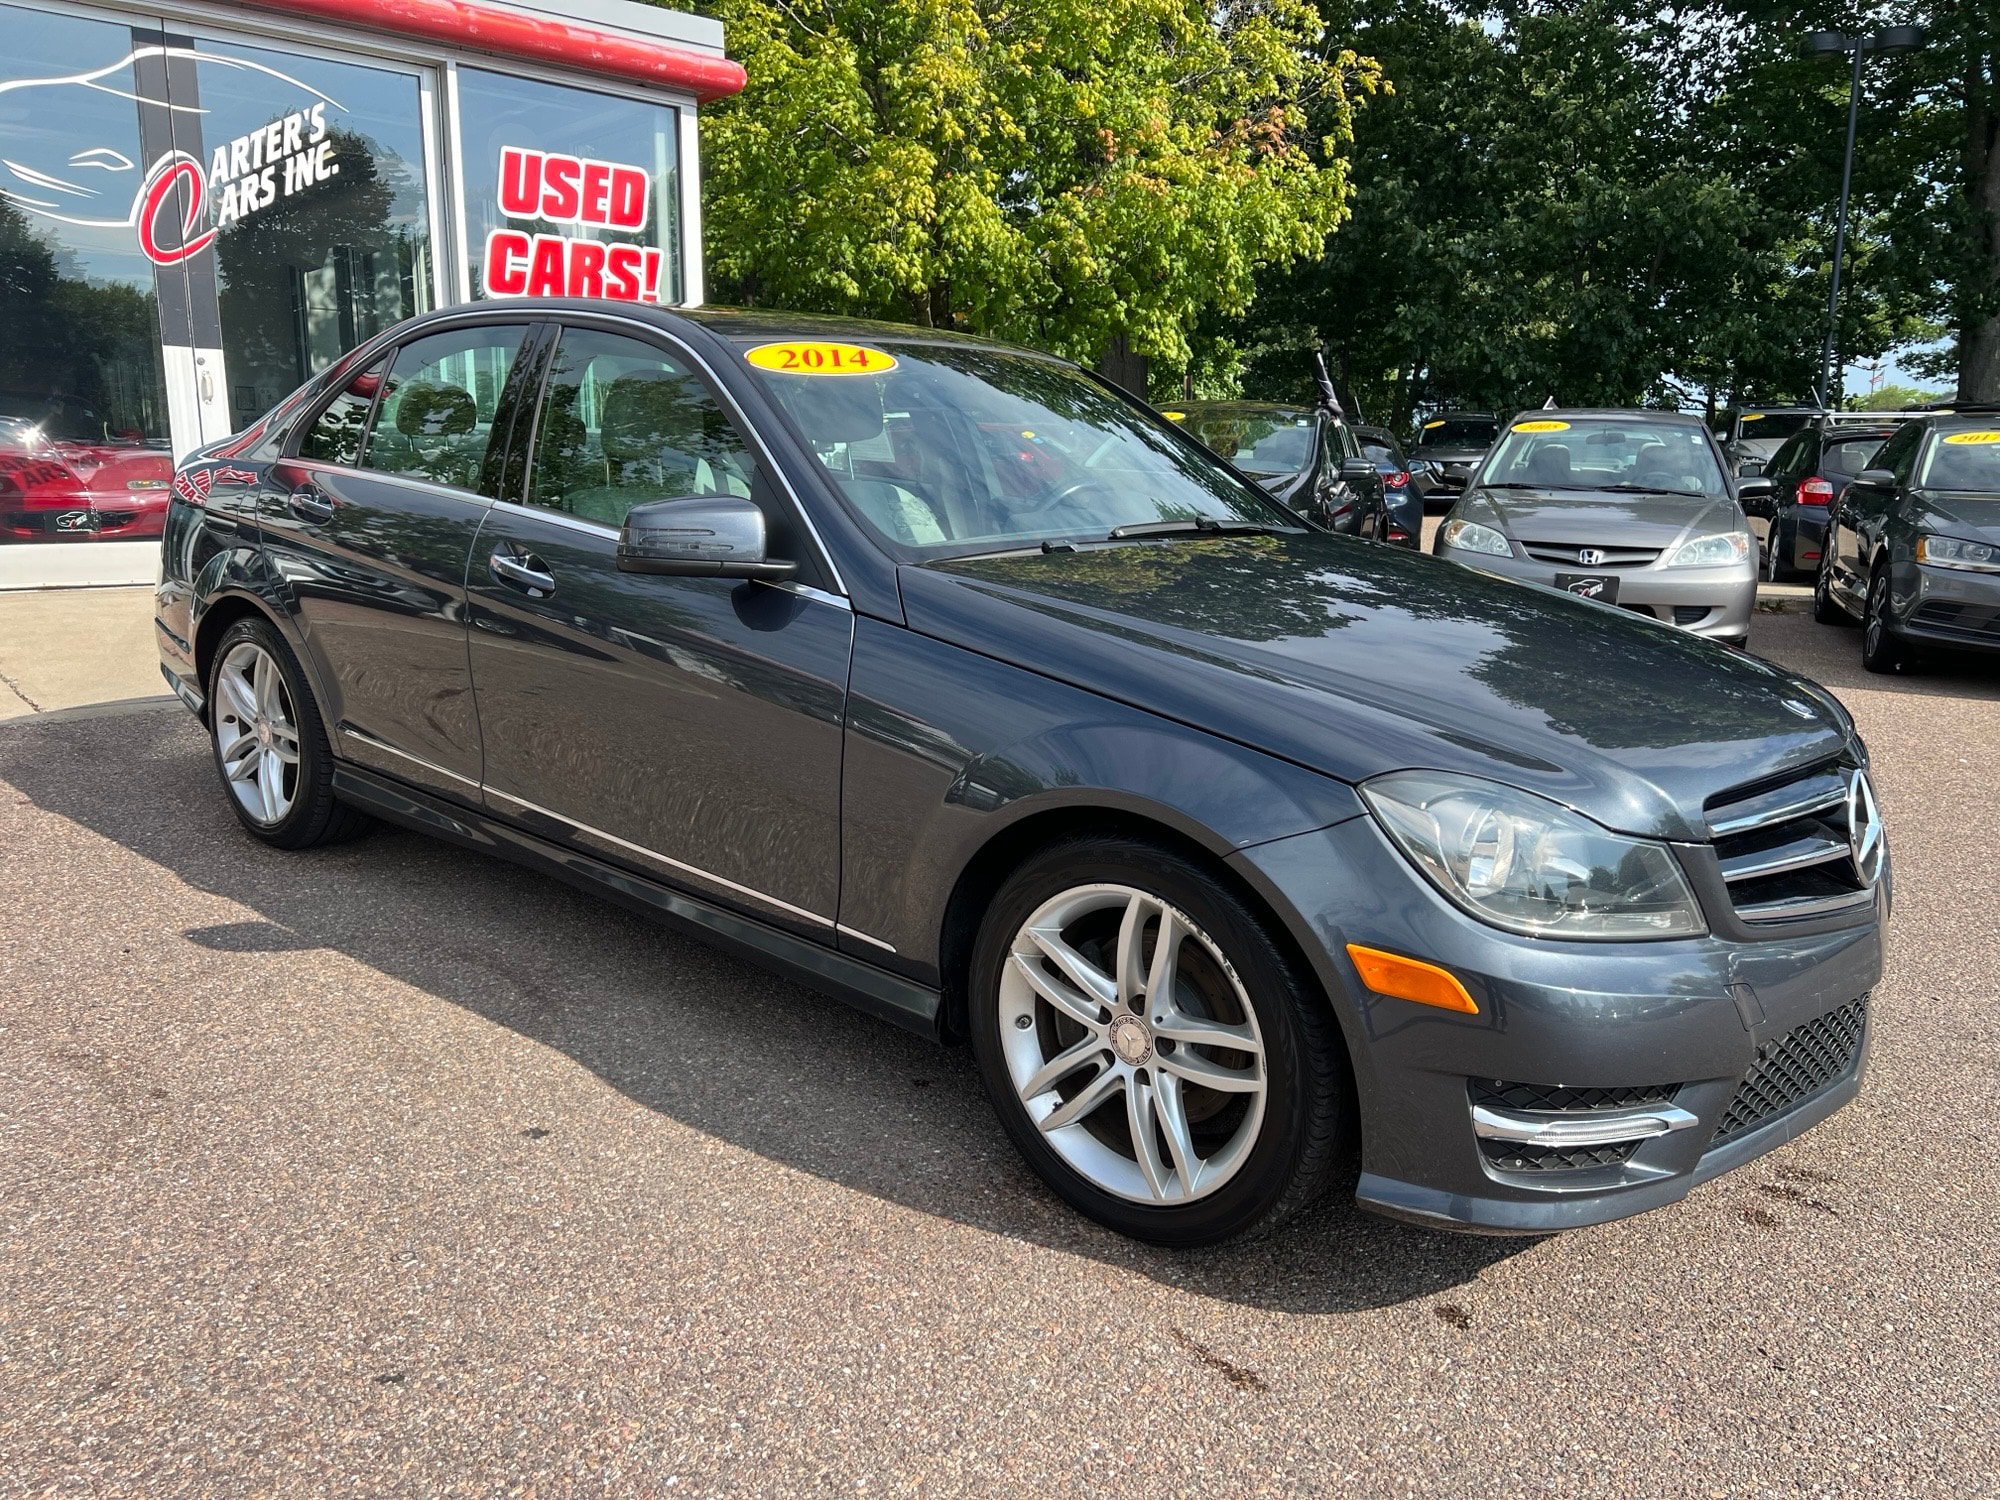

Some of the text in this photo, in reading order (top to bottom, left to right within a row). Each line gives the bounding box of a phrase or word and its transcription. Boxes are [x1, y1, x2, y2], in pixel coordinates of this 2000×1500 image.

[284, 140, 339, 196] INC.
[500, 149, 648, 230] USED
[486, 231, 662, 302] CARS!
[778, 349, 870, 369] 2014
